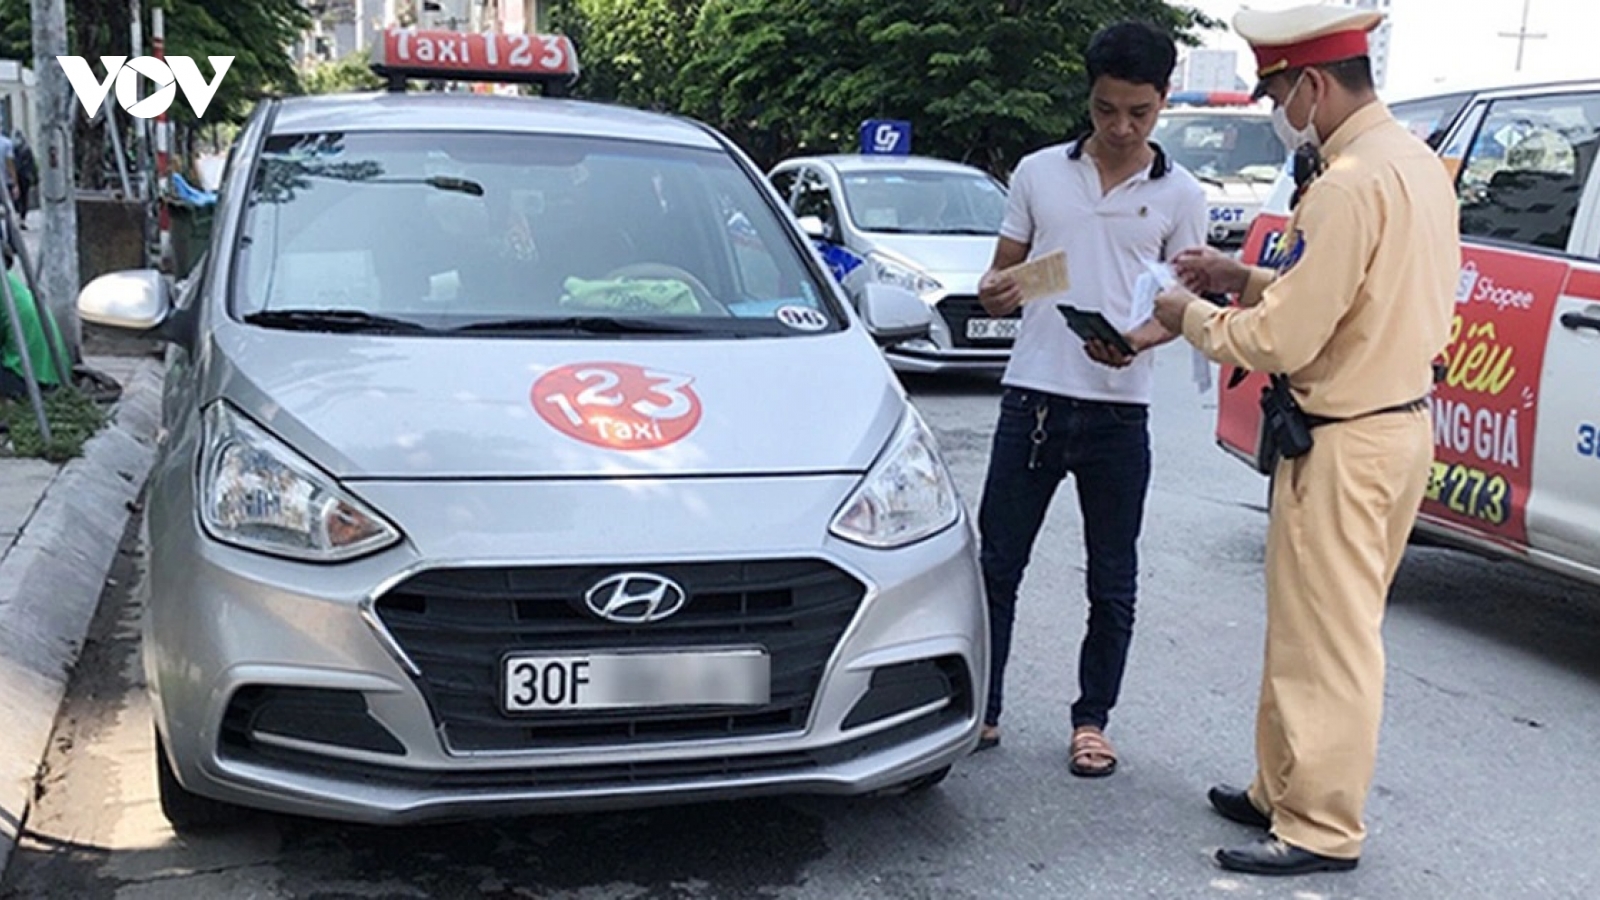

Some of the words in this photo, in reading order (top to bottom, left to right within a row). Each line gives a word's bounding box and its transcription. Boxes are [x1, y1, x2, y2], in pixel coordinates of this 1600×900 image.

[390, 28, 469, 63] Taxi
[1473, 277, 1534, 311] Shopee
[588, 415, 663, 441] Taxi
[1427, 396, 1472, 453] NG
[1474, 408, 1520, 469] GIÁ
[1449, 464, 1507, 524] 27.3
[513, 660, 590, 705] 30F
